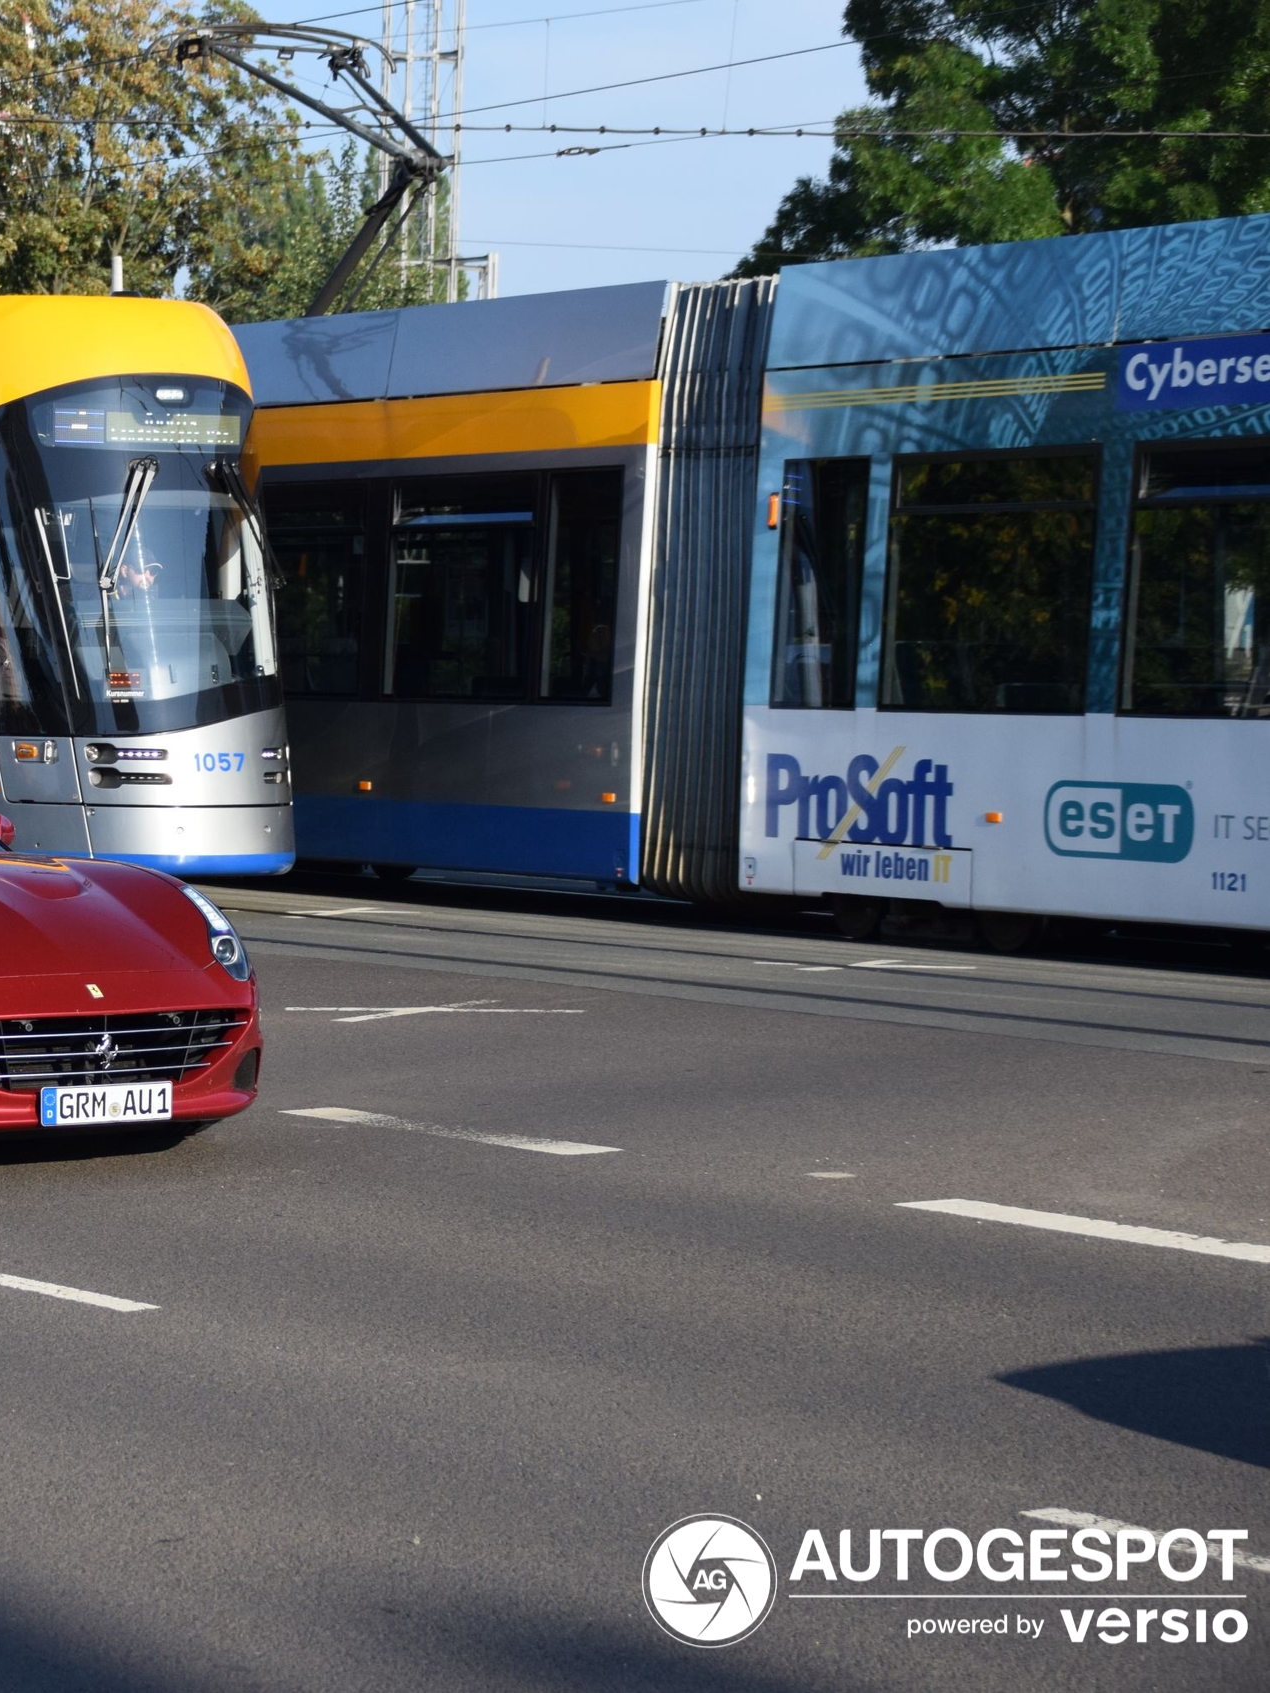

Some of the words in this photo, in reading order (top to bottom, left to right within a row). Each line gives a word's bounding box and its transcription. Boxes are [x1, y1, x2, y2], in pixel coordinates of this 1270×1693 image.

[1125, 347, 1270, 400] Cyberse
[194, 753, 245, 772] 1057
[764, 752, 953, 847] ProSoft
[1213, 814, 1235, 839] IT
[1242, 815, 1270, 841] SE
[840, 850, 870, 878] wir
[875, 851, 929, 882] leben
[933, 854, 952, 883] IT
[1211, 872, 1247, 892] 1121
[46, 1110, 53, 1118] D
[59, 1091, 106, 1119] GRM
[123, 1088, 169, 1116] AU1
